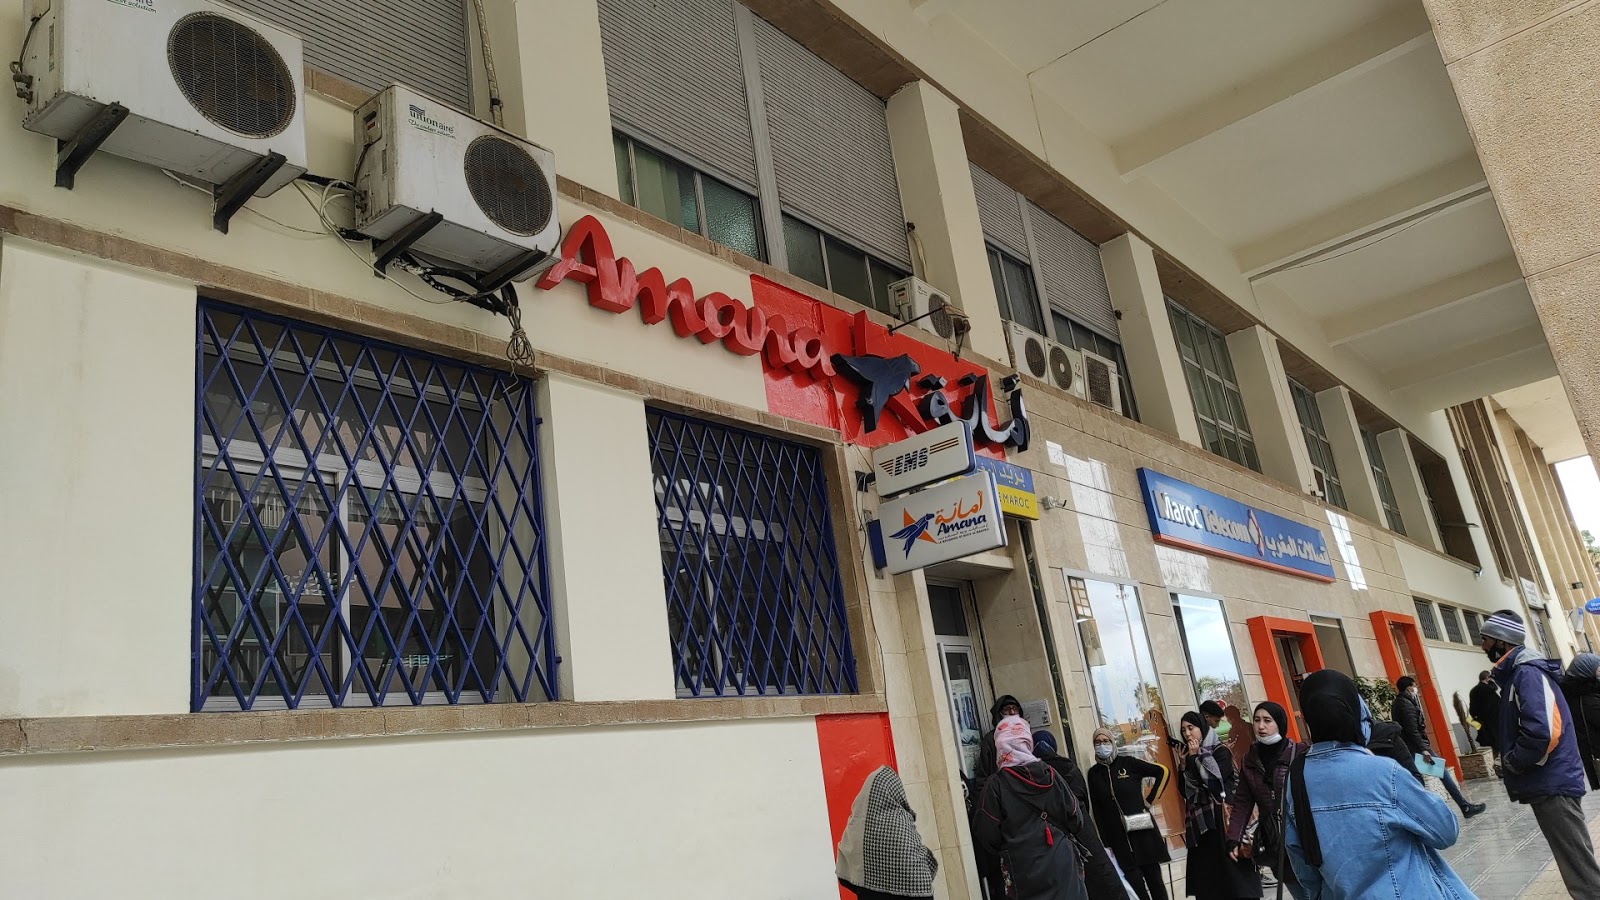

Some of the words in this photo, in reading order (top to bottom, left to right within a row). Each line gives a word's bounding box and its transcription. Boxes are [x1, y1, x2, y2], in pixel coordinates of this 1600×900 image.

[535, 215, 837, 379] Amana
[894, 447, 928, 476] EMS
[998, 466, 1026, 488] بريد
[935, 490, 983, 525] أمانة
[1002, 493, 1030, 509] MAROC
[937, 514, 987, 536] Amana
[1153, 489, 1203, 530] Maroc
[1198, 504, 1251, 544] Telecom
[1264, 533, 1299, 559] المغرب
